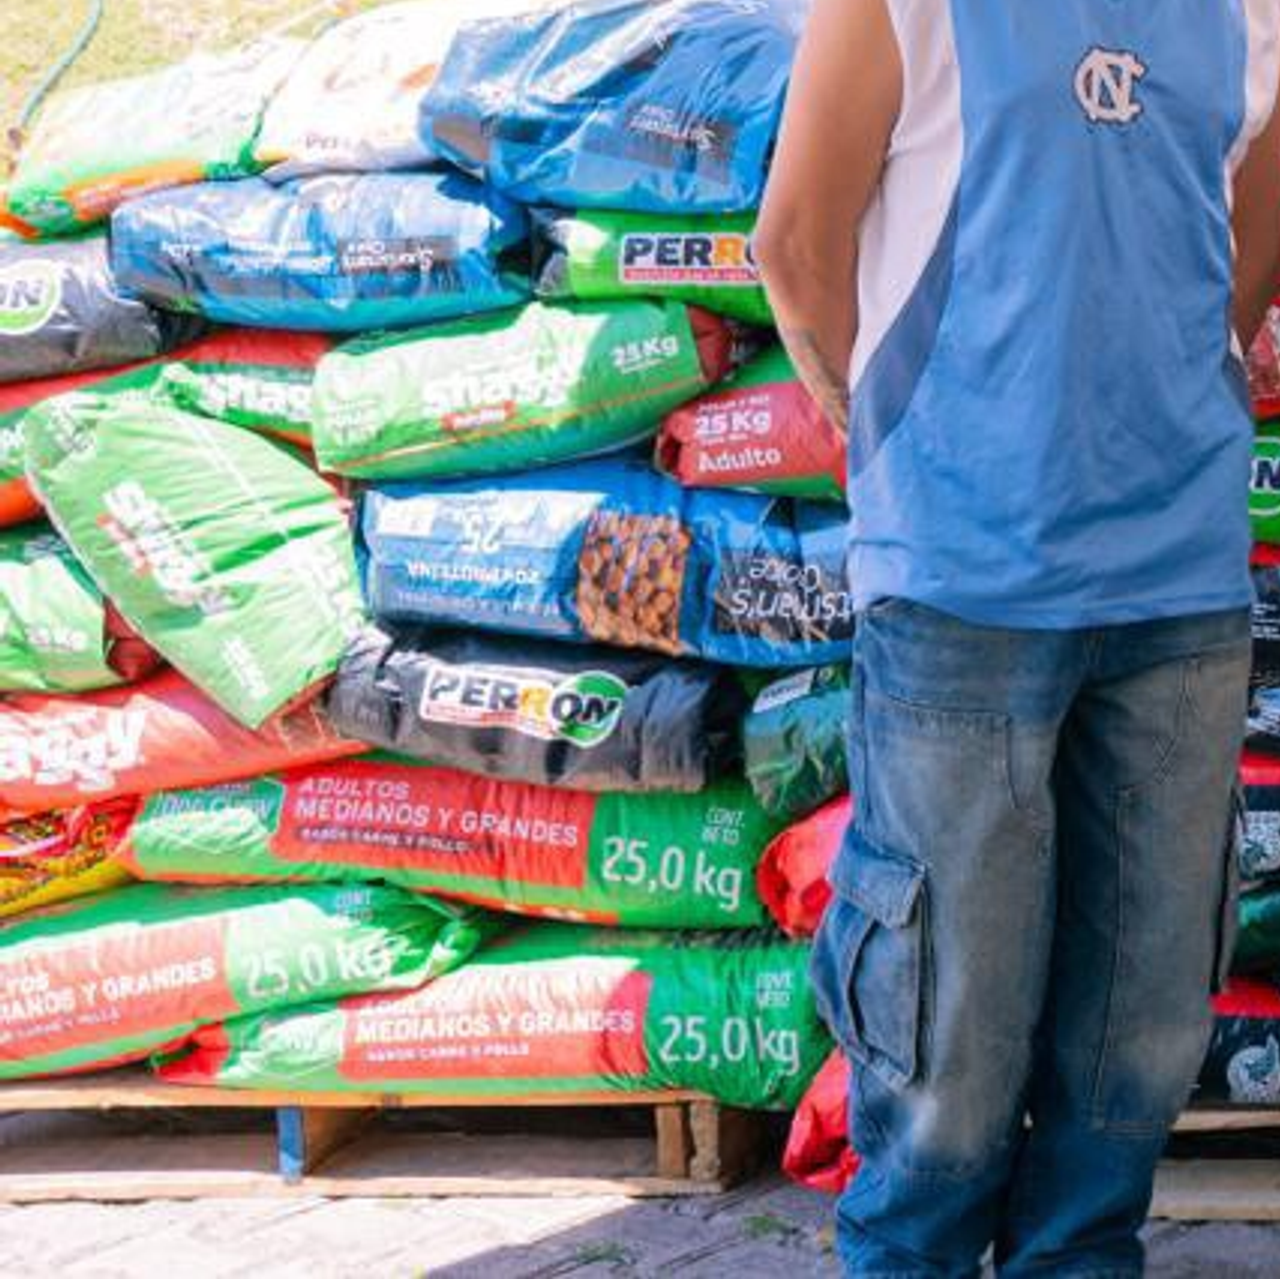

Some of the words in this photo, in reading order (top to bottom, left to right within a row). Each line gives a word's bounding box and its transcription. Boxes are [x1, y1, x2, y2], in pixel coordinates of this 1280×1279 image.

[622, 235, 754, 268] PERR
[700, 446, 782, 473] Adulto
[427, 670, 621, 726] PERRON
[300, 777, 410, 799] ADULTOS
[297, 799, 430, 829] MEDIANOS
[439, 807, 453, 828] Y
[460, 810, 579, 847] GRANDES
[602, 836, 685, 893] 25,0
[692, 852, 743, 911] kg
[102, 956, 217, 997] GRANDES
[355, 1012, 492, 1043] MEDIANOS
[497, 1011, 511, 1036] Y
[519, 1008, 635, 1037] GRANDES
[659, 1015, 748, 1070] 25,0
[756, 1019, 801, 1076] kg
